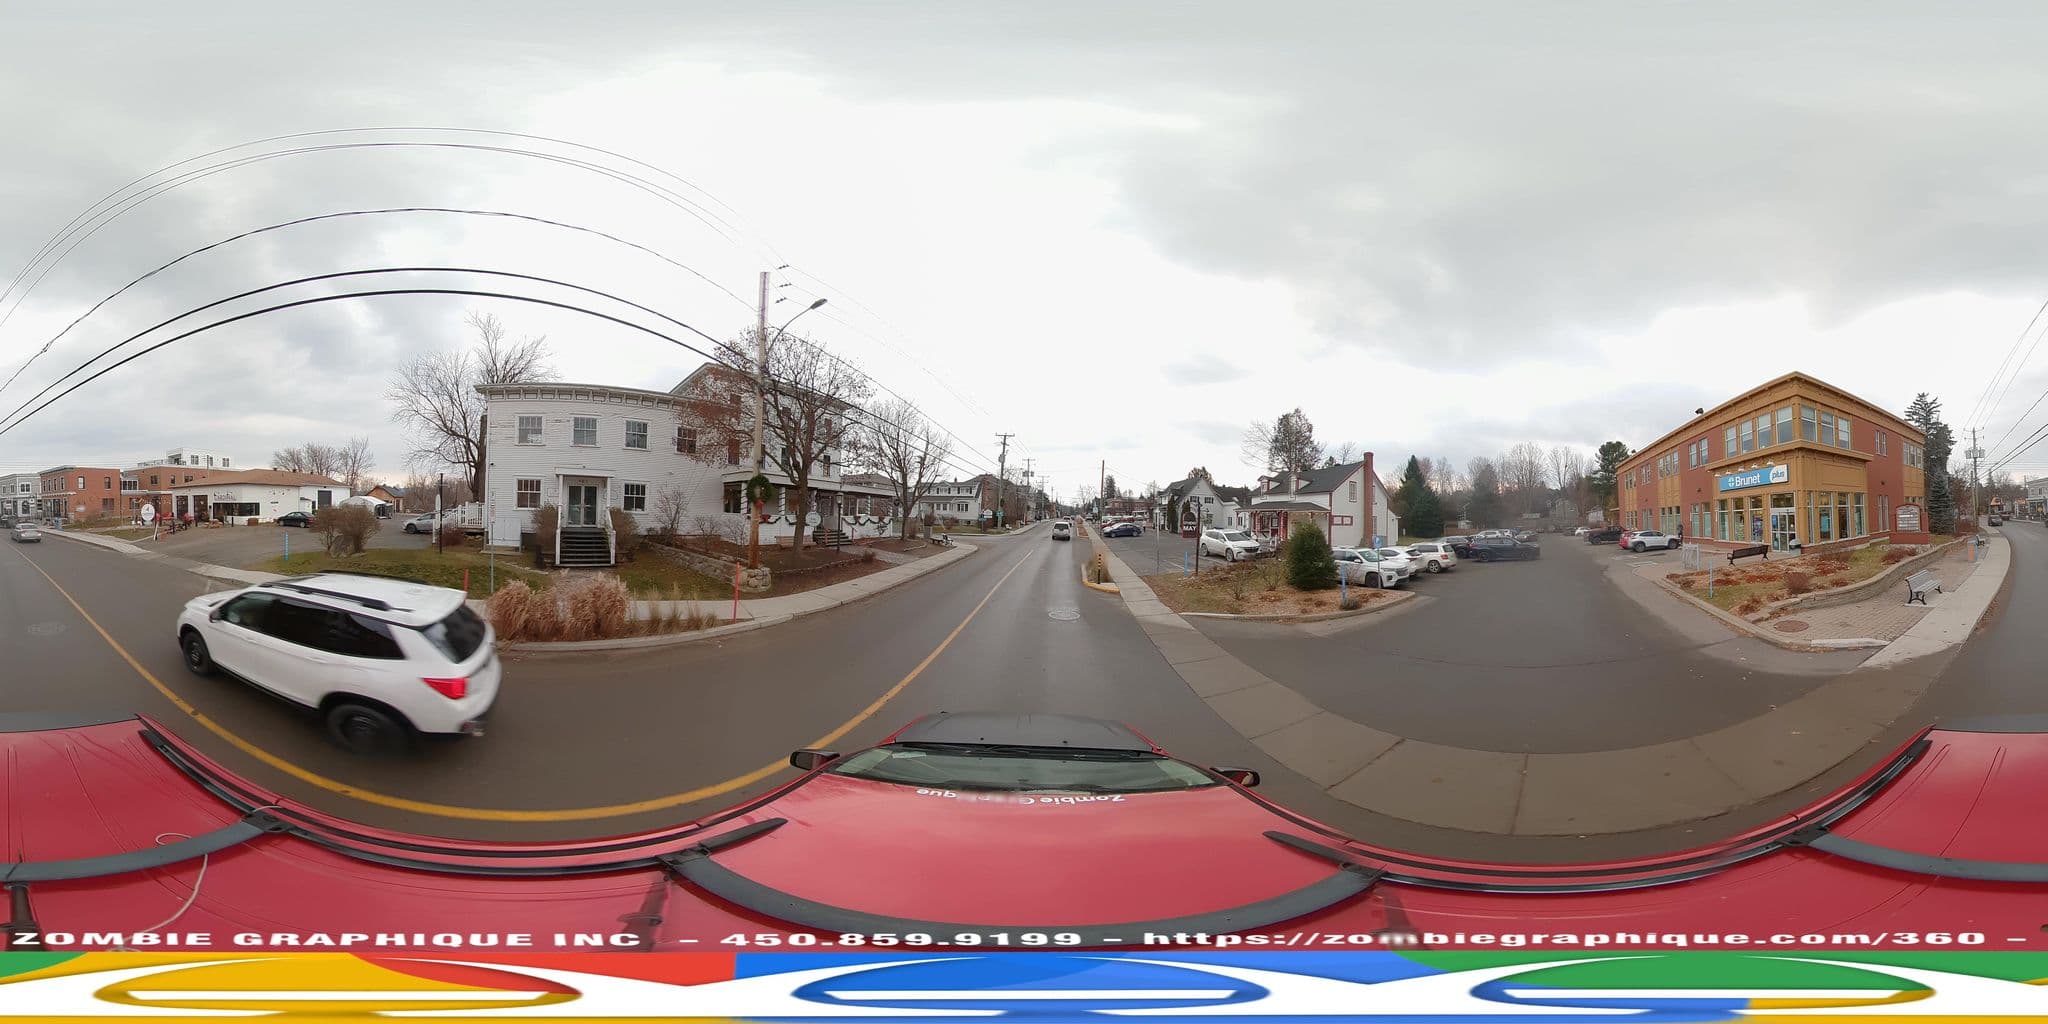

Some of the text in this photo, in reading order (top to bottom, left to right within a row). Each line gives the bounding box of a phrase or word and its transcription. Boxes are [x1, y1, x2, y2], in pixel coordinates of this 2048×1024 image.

[1735, 470, 1785, 487] Brunet plus
[1040, 793, 1127, 804] Zombie
